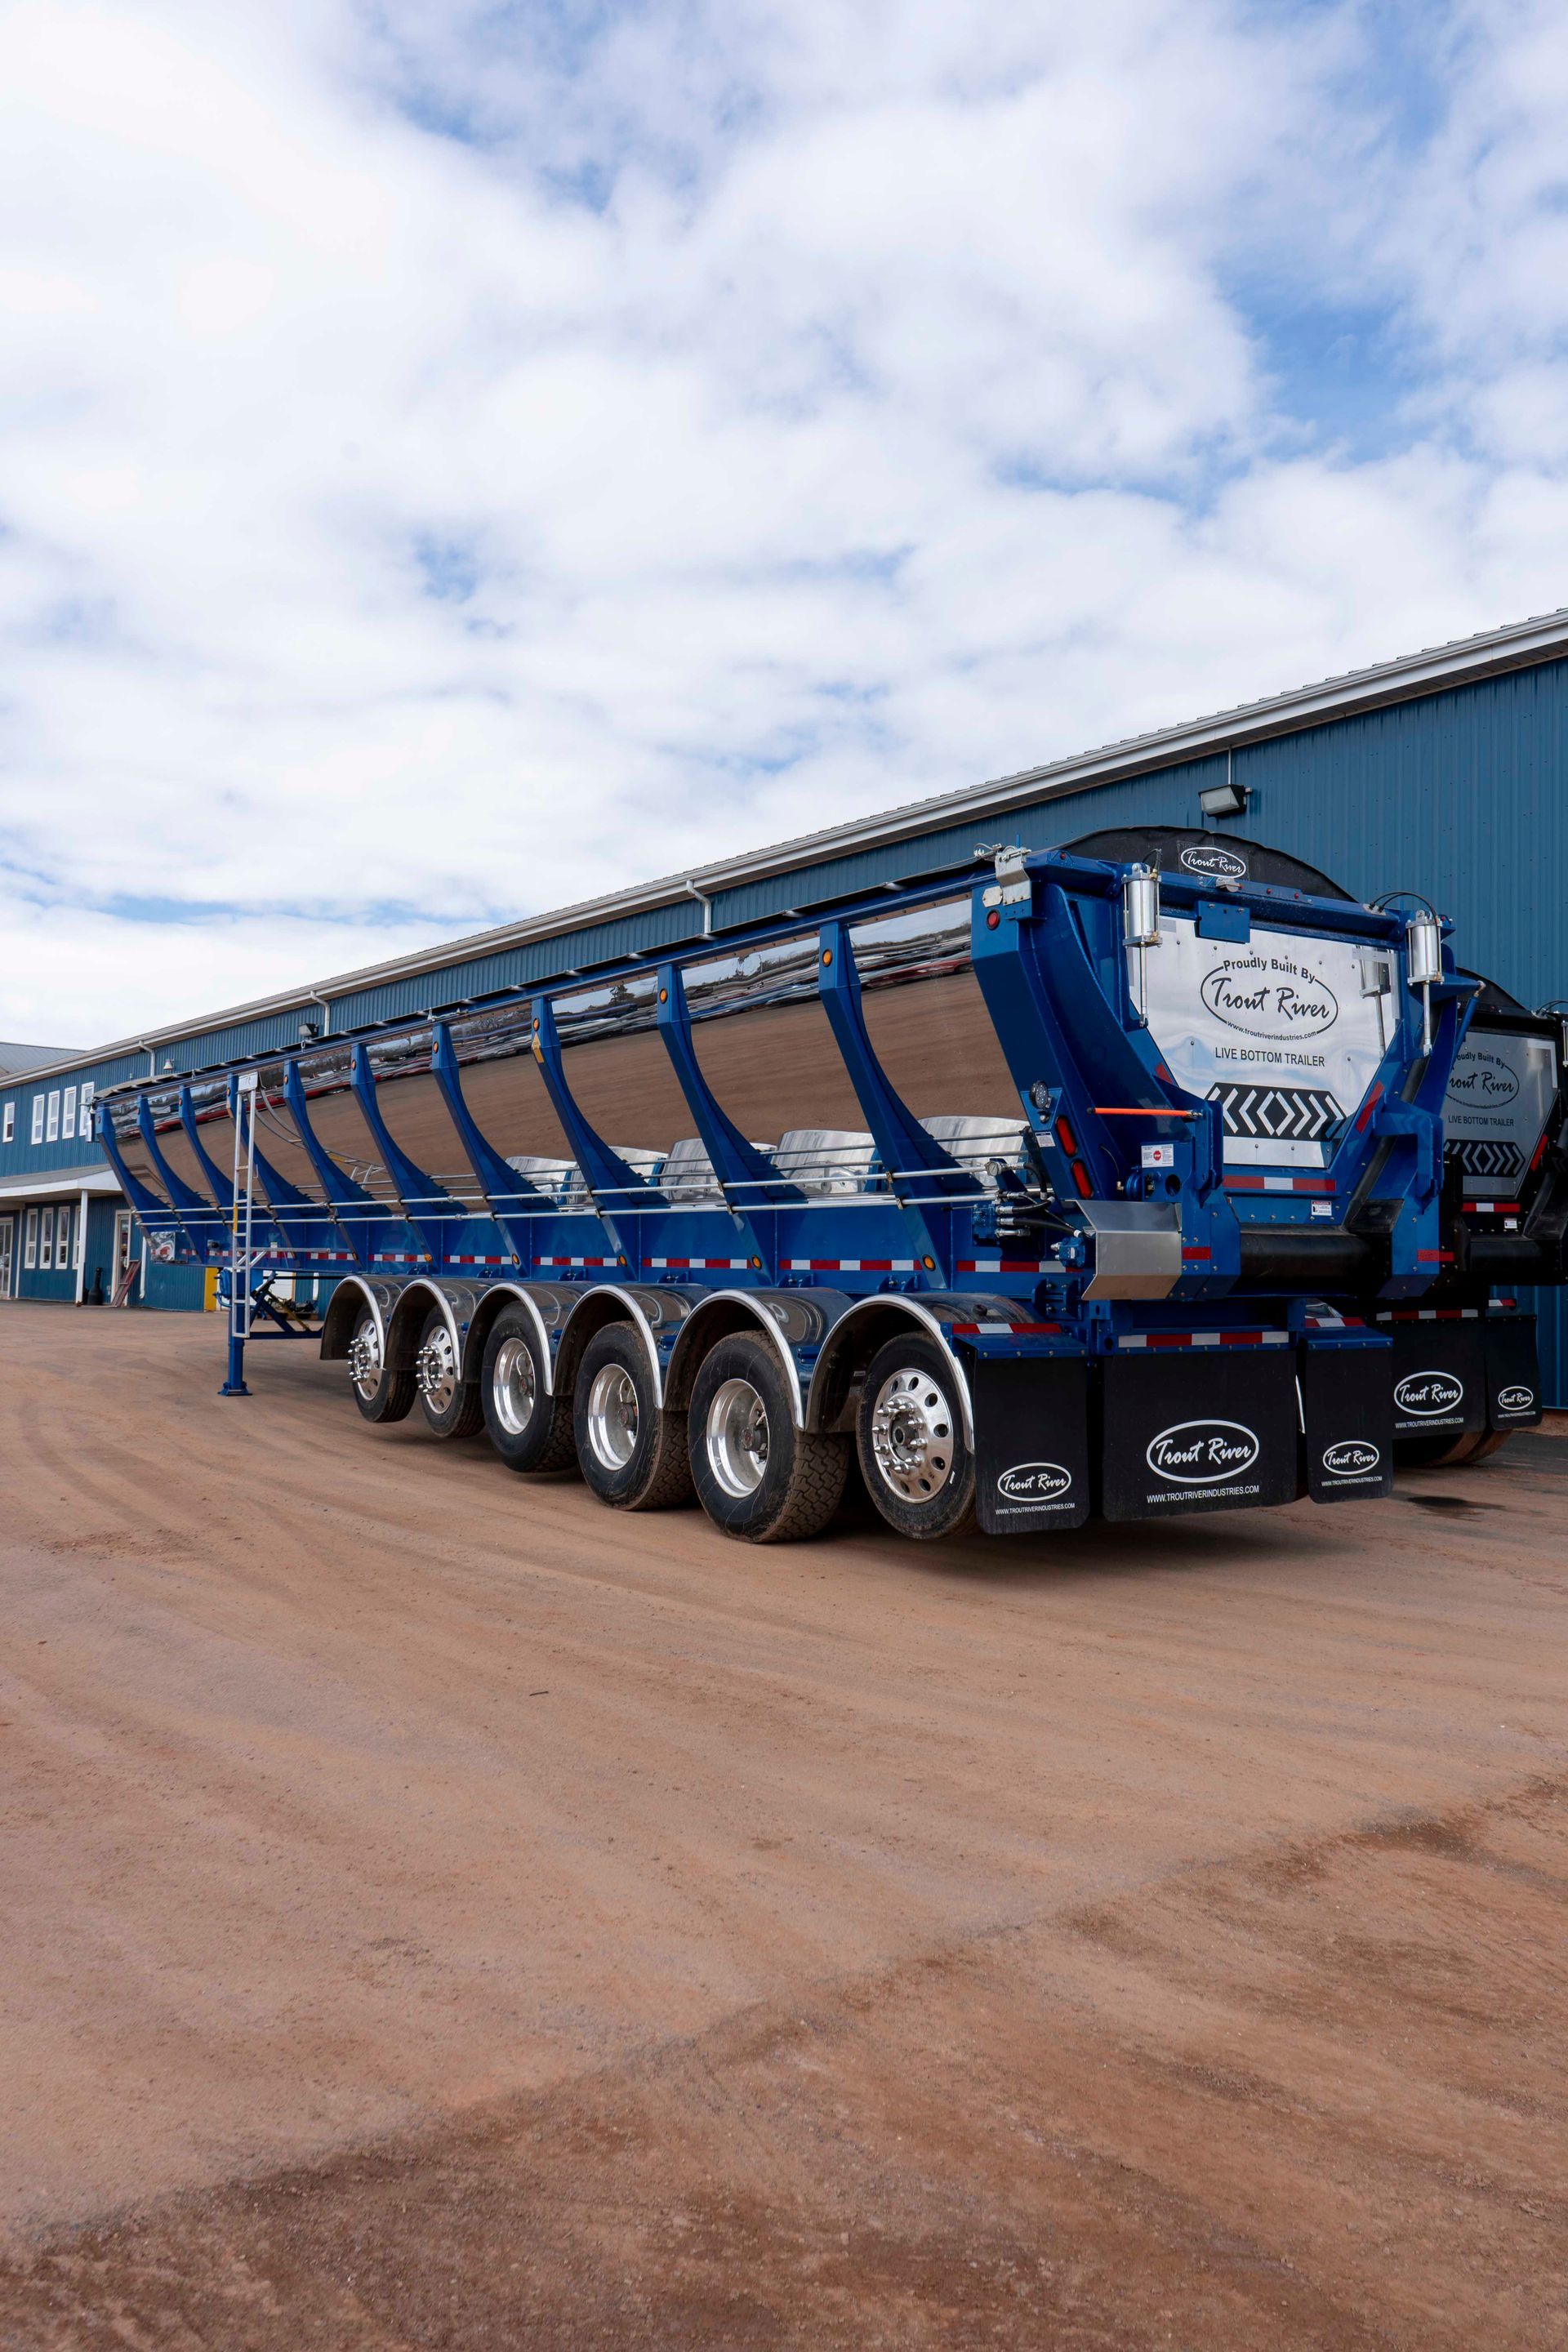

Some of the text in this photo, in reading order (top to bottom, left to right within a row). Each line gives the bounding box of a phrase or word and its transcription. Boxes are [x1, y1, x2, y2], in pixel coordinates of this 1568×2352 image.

[1187, 851, 1242, 873] Trout River
[1223, 957, 1316, 984] Proudly Built By
[1211, 978, 1330, 1021] Trout River
[1227, 1021, 1316, 1041] www.troutriverindustries.com
[1215, 1047, 1325, 1067] LIVE BOTTOM TRAILER
[1456, 1052, 1505, 1069] oudly Built By
[1449, 1067, 1514, 1095] rout River
[1448, 1116, 1514, 1127] LIVE BOTTOM TRAILER
[1399, 1383, 1459, 1403] Trout River
[1156, 1437, 1251, 1465] Trout River
[1327, 1450, 1375, 1466] Trout River
[1004, 1473, 1067, 1491] Trout River
[1147, 1485, 1259, 1503] WWW.TROUTRIVERINDUSTRIES.COM
[996, 1503, 1075, 1515] WWW.TROUTRIVERINDUSTRIES.COM
